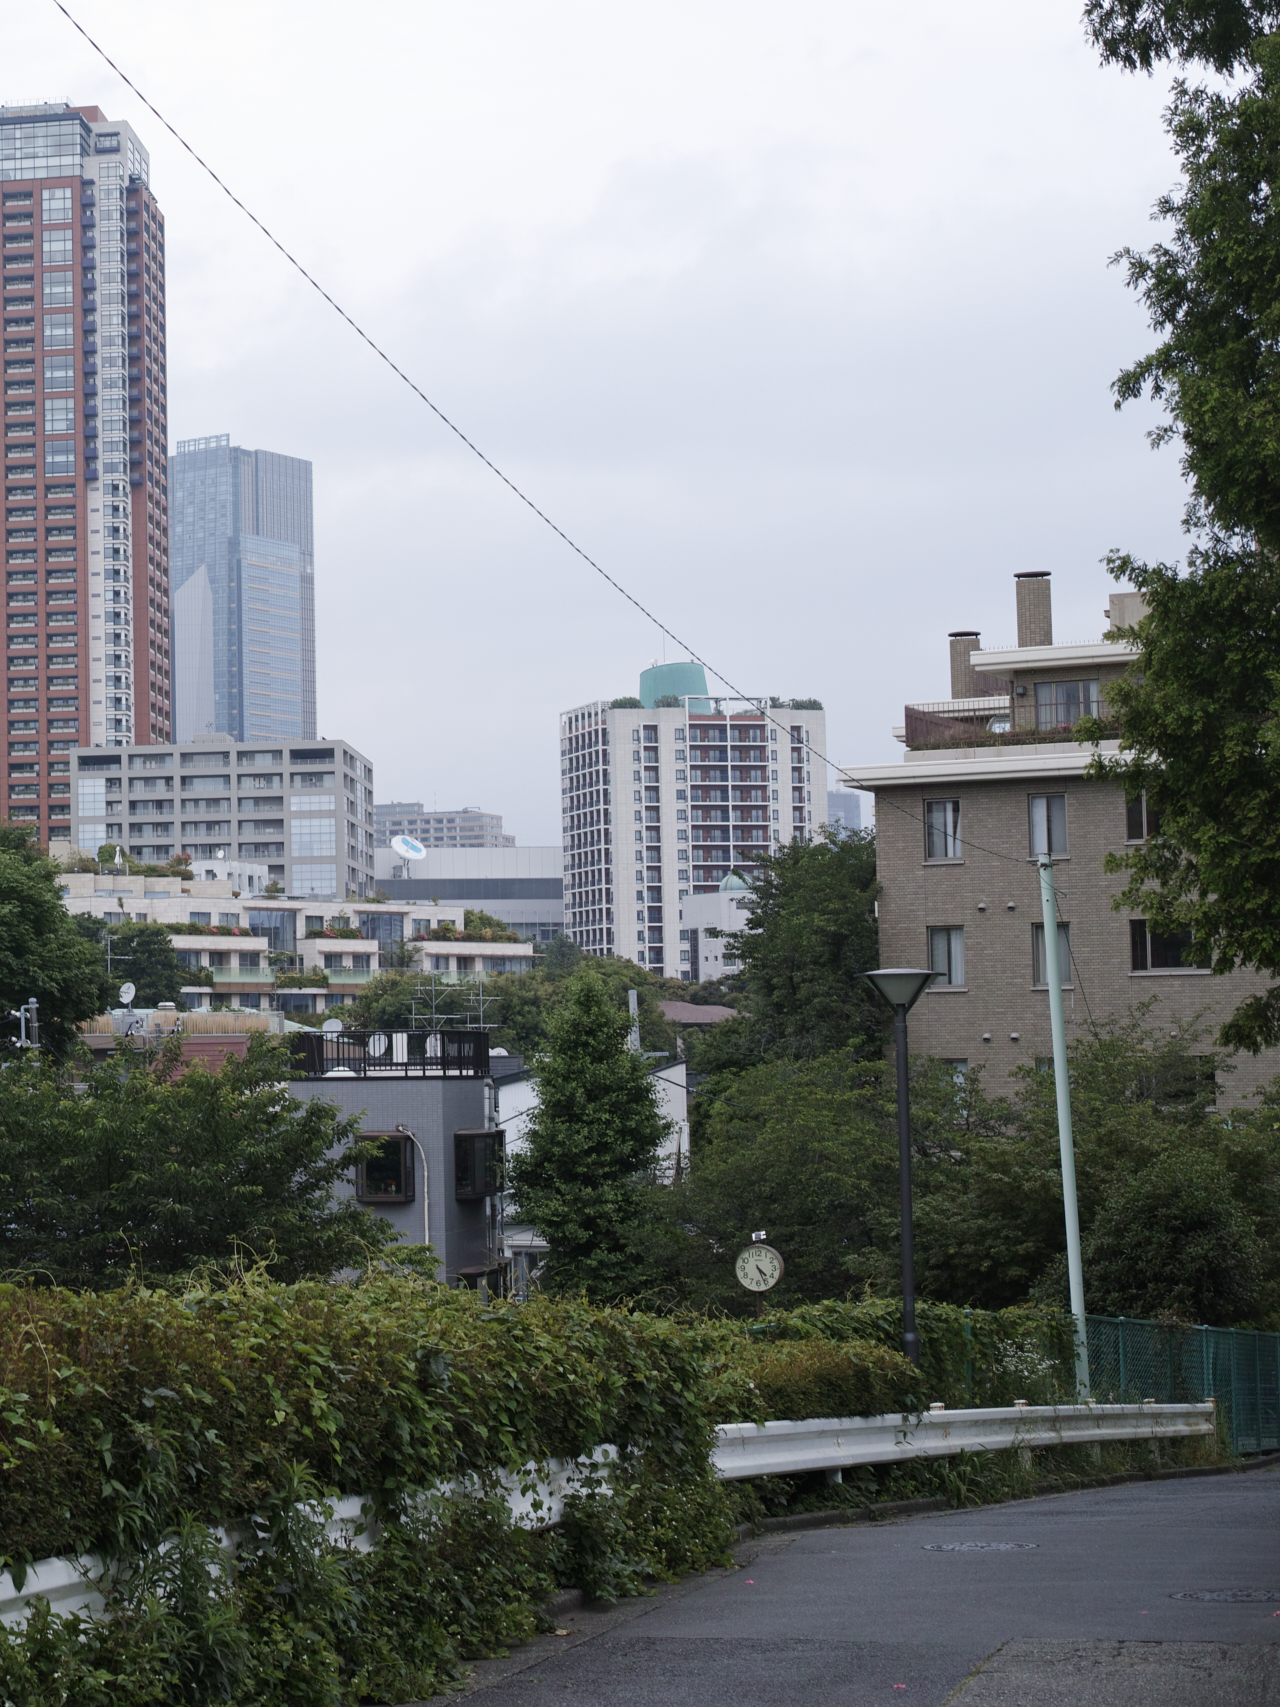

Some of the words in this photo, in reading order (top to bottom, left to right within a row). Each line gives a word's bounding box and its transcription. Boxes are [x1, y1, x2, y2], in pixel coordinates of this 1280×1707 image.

[740, 1264, 745, 1272] 9
[771, 1264, 777, 1272] 3
[756, 1279, 761, 1287] 6
